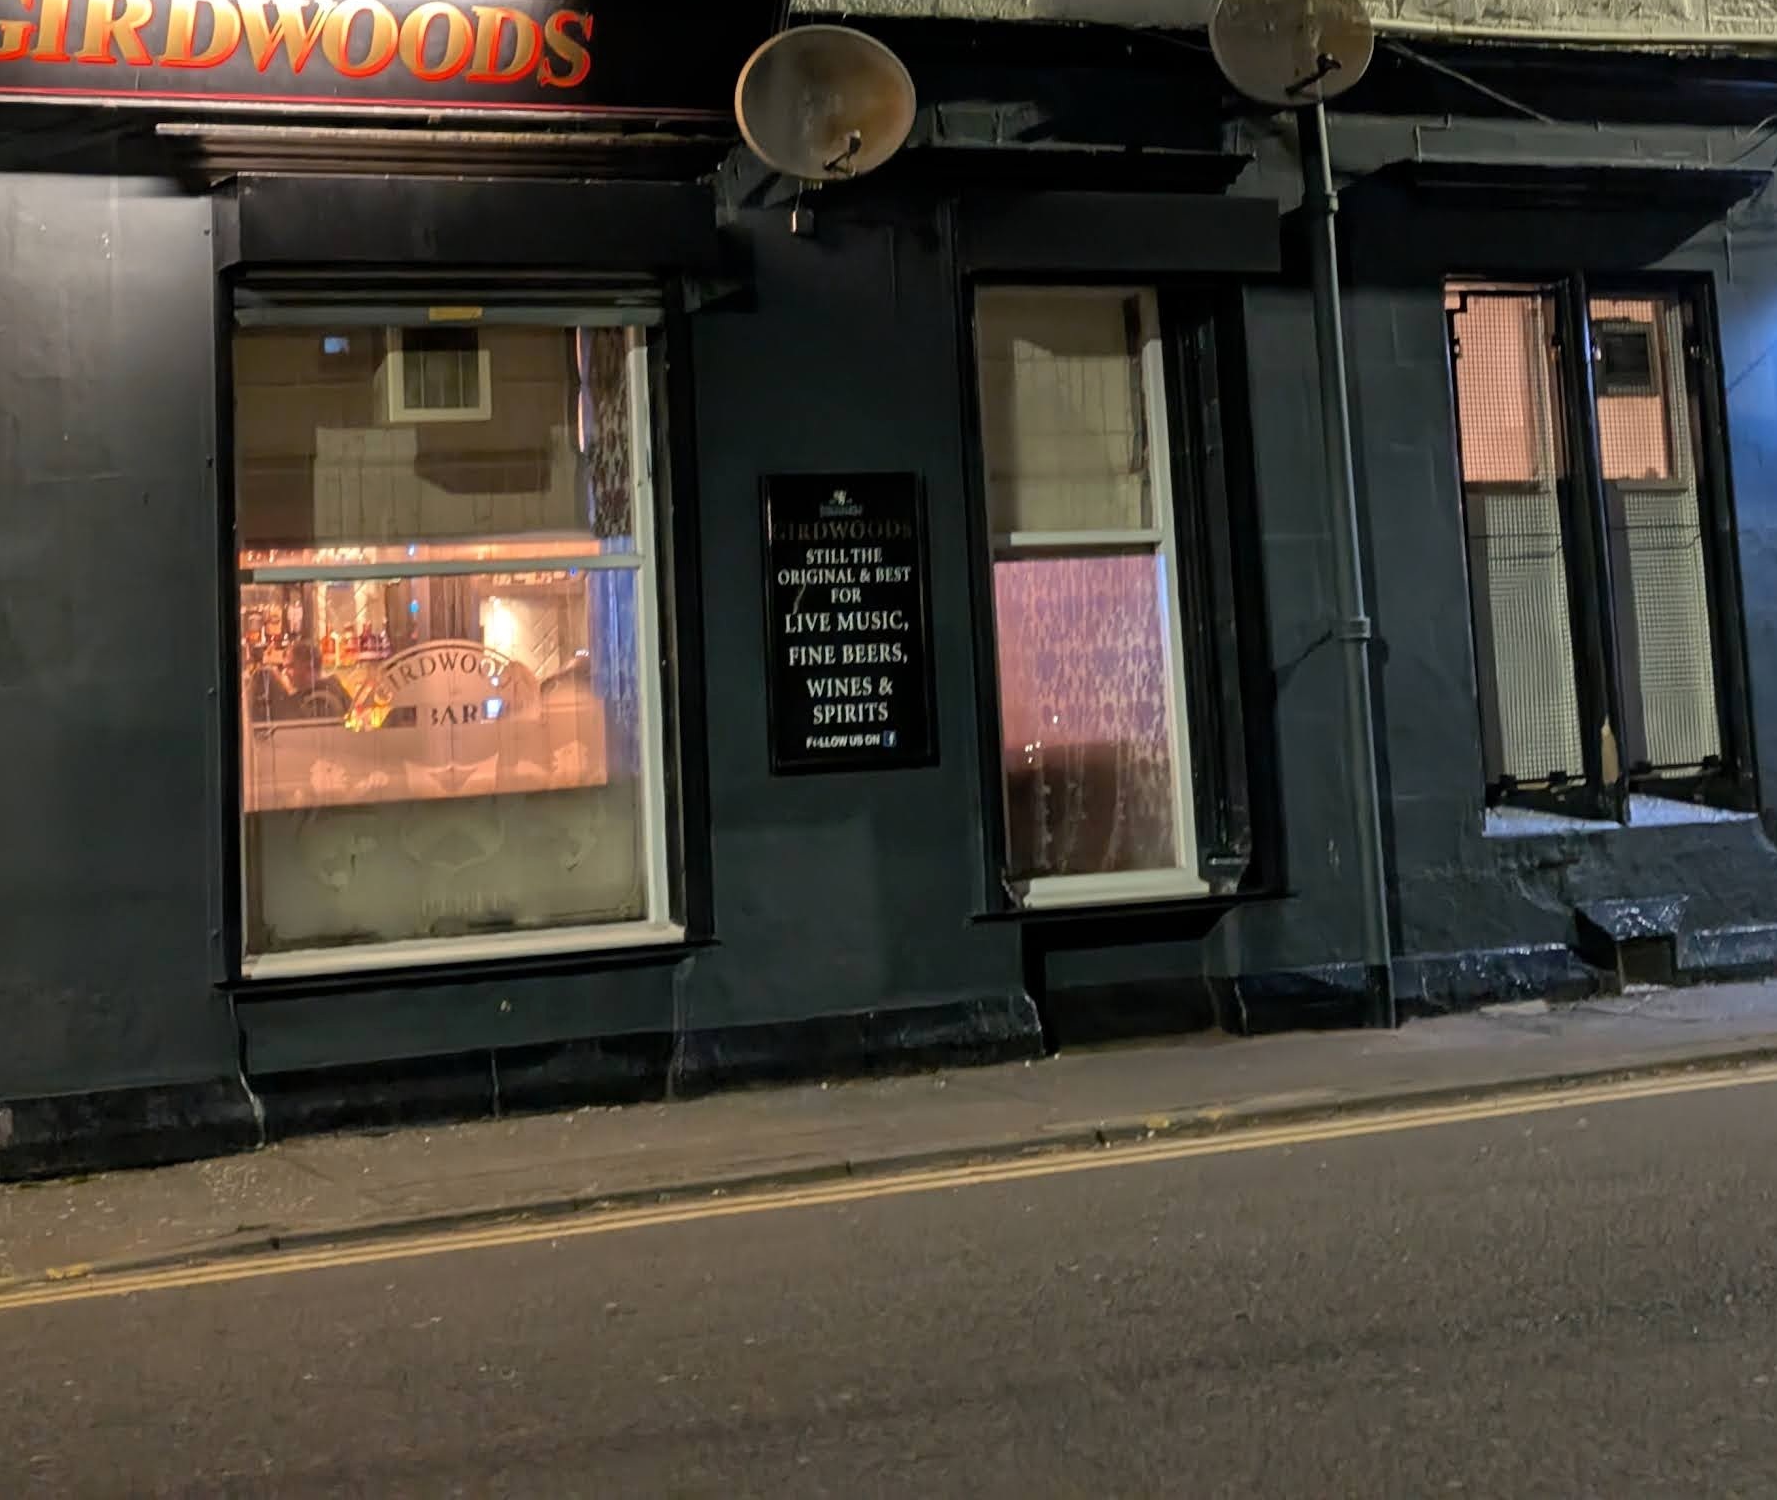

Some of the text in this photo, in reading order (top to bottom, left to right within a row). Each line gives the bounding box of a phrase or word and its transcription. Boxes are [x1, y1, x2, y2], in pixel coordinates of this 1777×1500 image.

[773, 518, 912, 541] GIRDWOODS
[805, 547, 883, 565] STILL THE
[778, 566, 912, 585] ORIGINAL & BEST
[831, 587, 862, 604] FOR
[785, 610, 910, 633] LIVE MUSIC,
[789, 642, 908, 666] FINE BEERS,
[806, 676, 894, 698] WINES &
[813, 701, 889, 725] SPIRITS
[806, 734, 848, 749] FOLLOW
